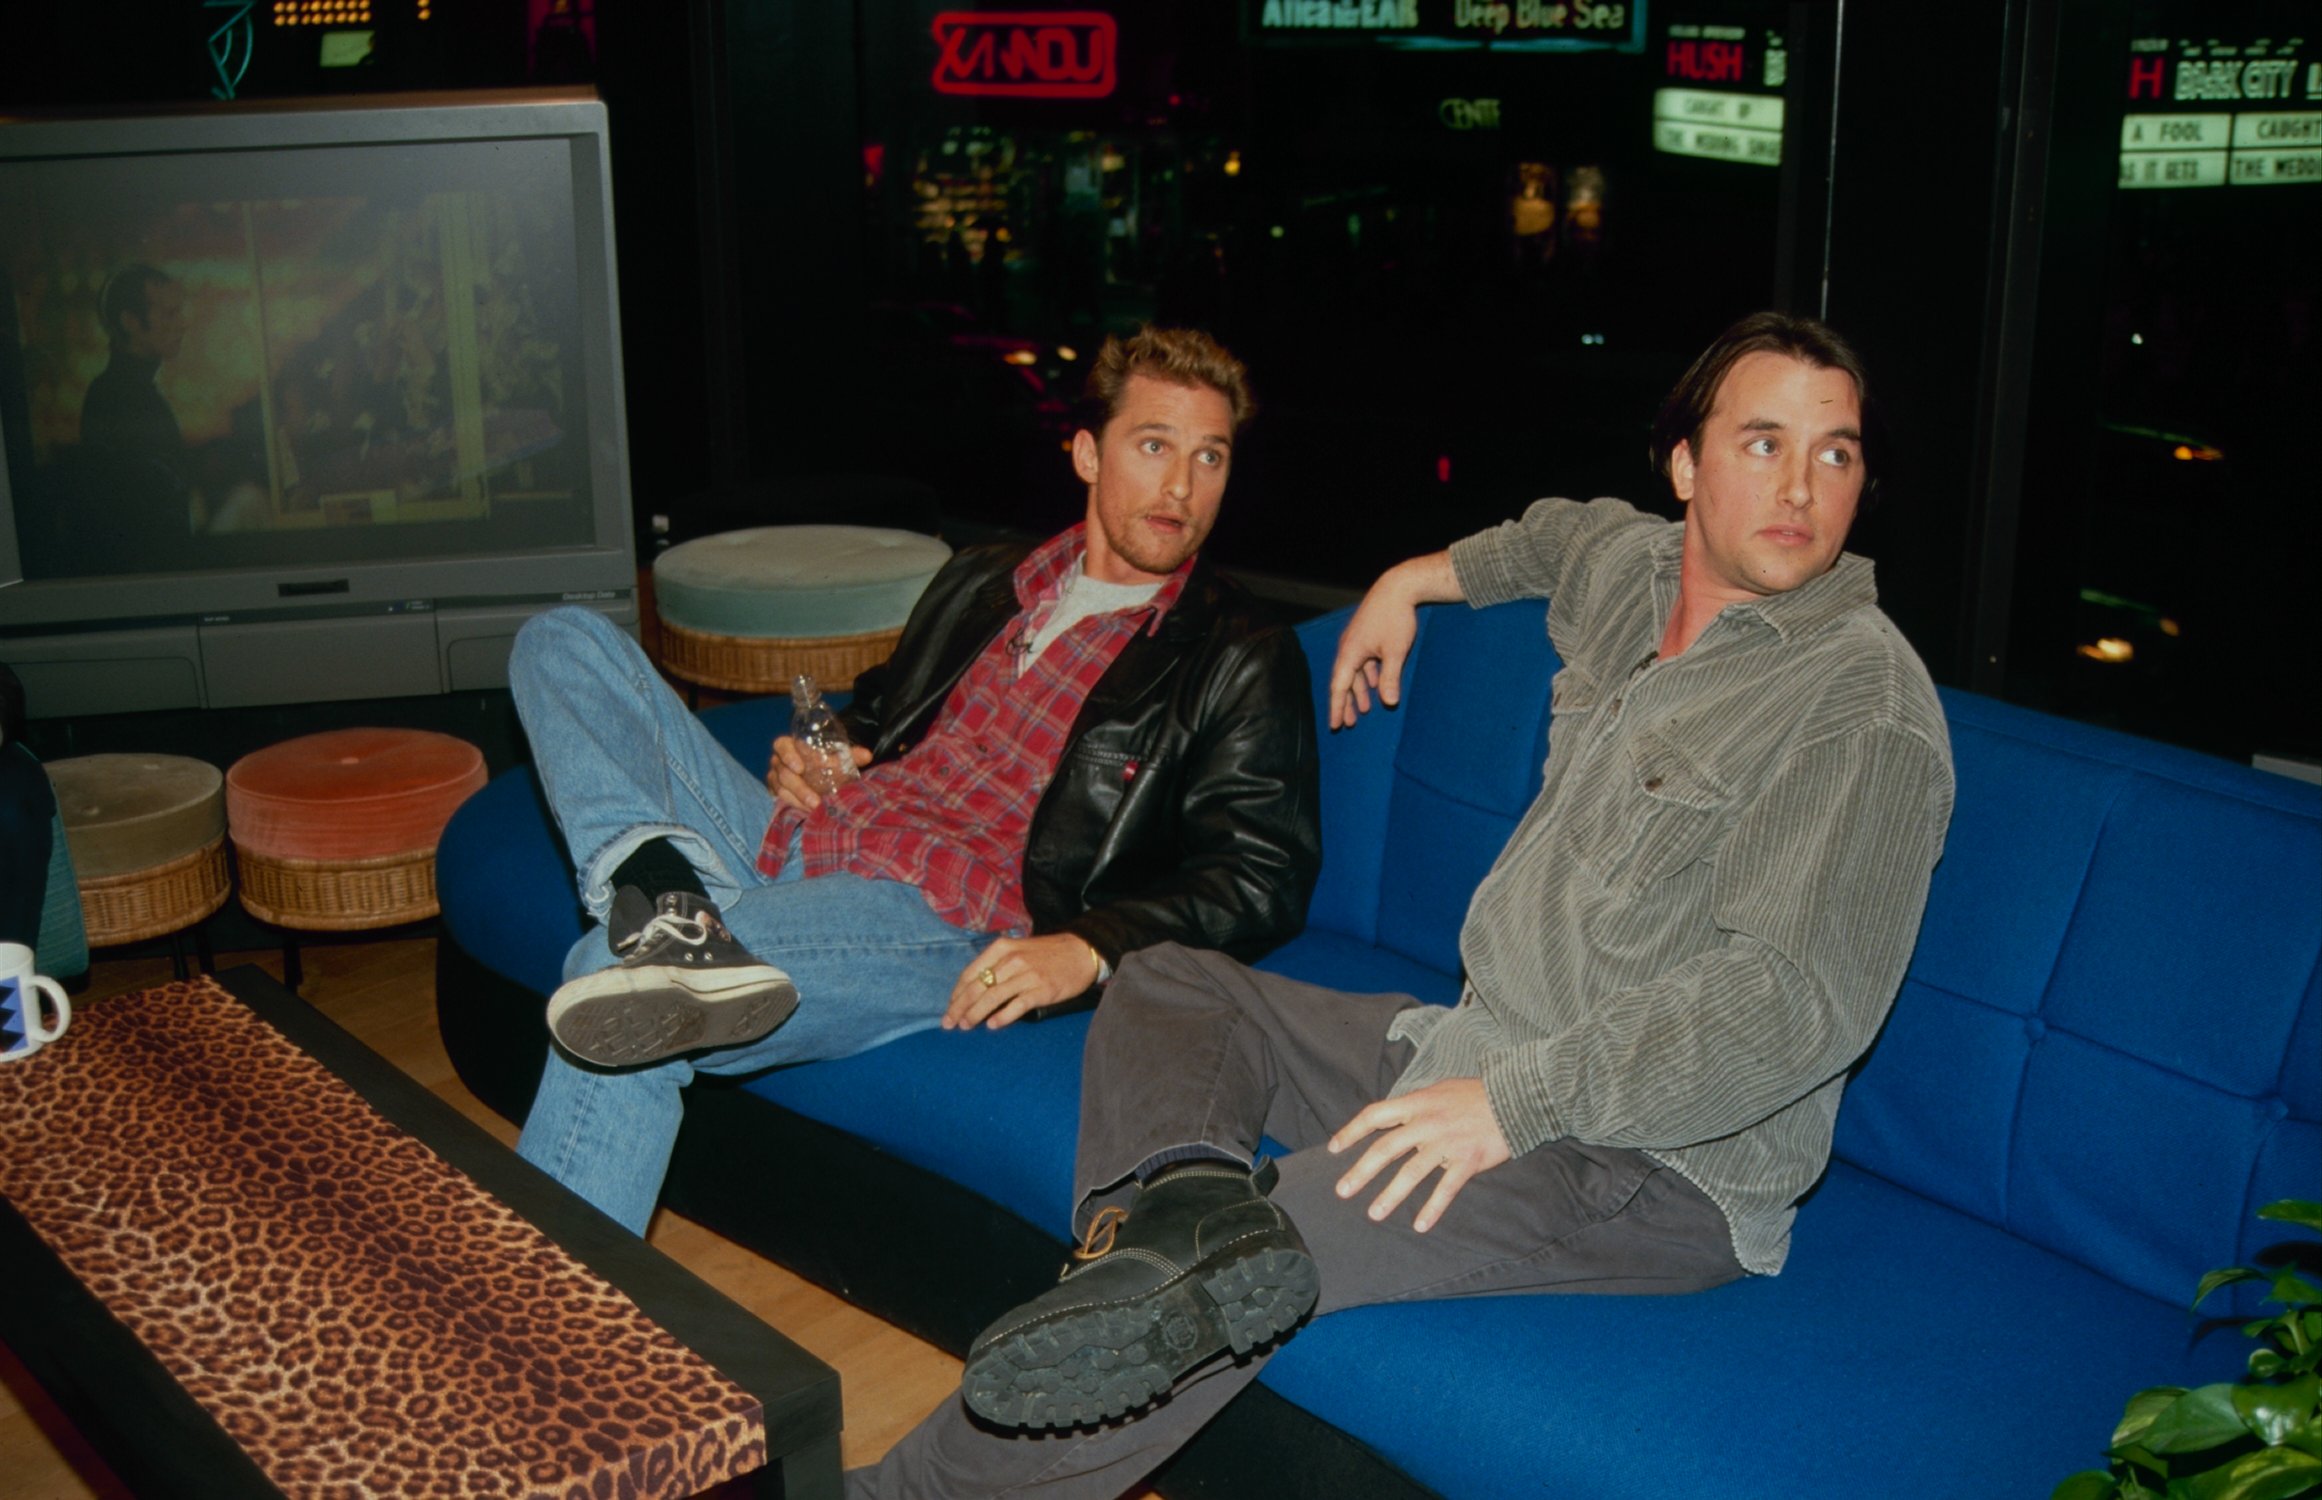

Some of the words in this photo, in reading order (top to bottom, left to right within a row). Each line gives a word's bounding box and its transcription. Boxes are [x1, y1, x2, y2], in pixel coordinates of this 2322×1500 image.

[1573, 0, 1624, 29] Sea
[1667, 41, 1742, 81] HUSH
[2175, 61, 2243, 99] DARK
[2242, 60, 2298, 98] CITY
[2159, 120, 2203, 142] FOOL
[2235, 157, 2264, 178] THE
